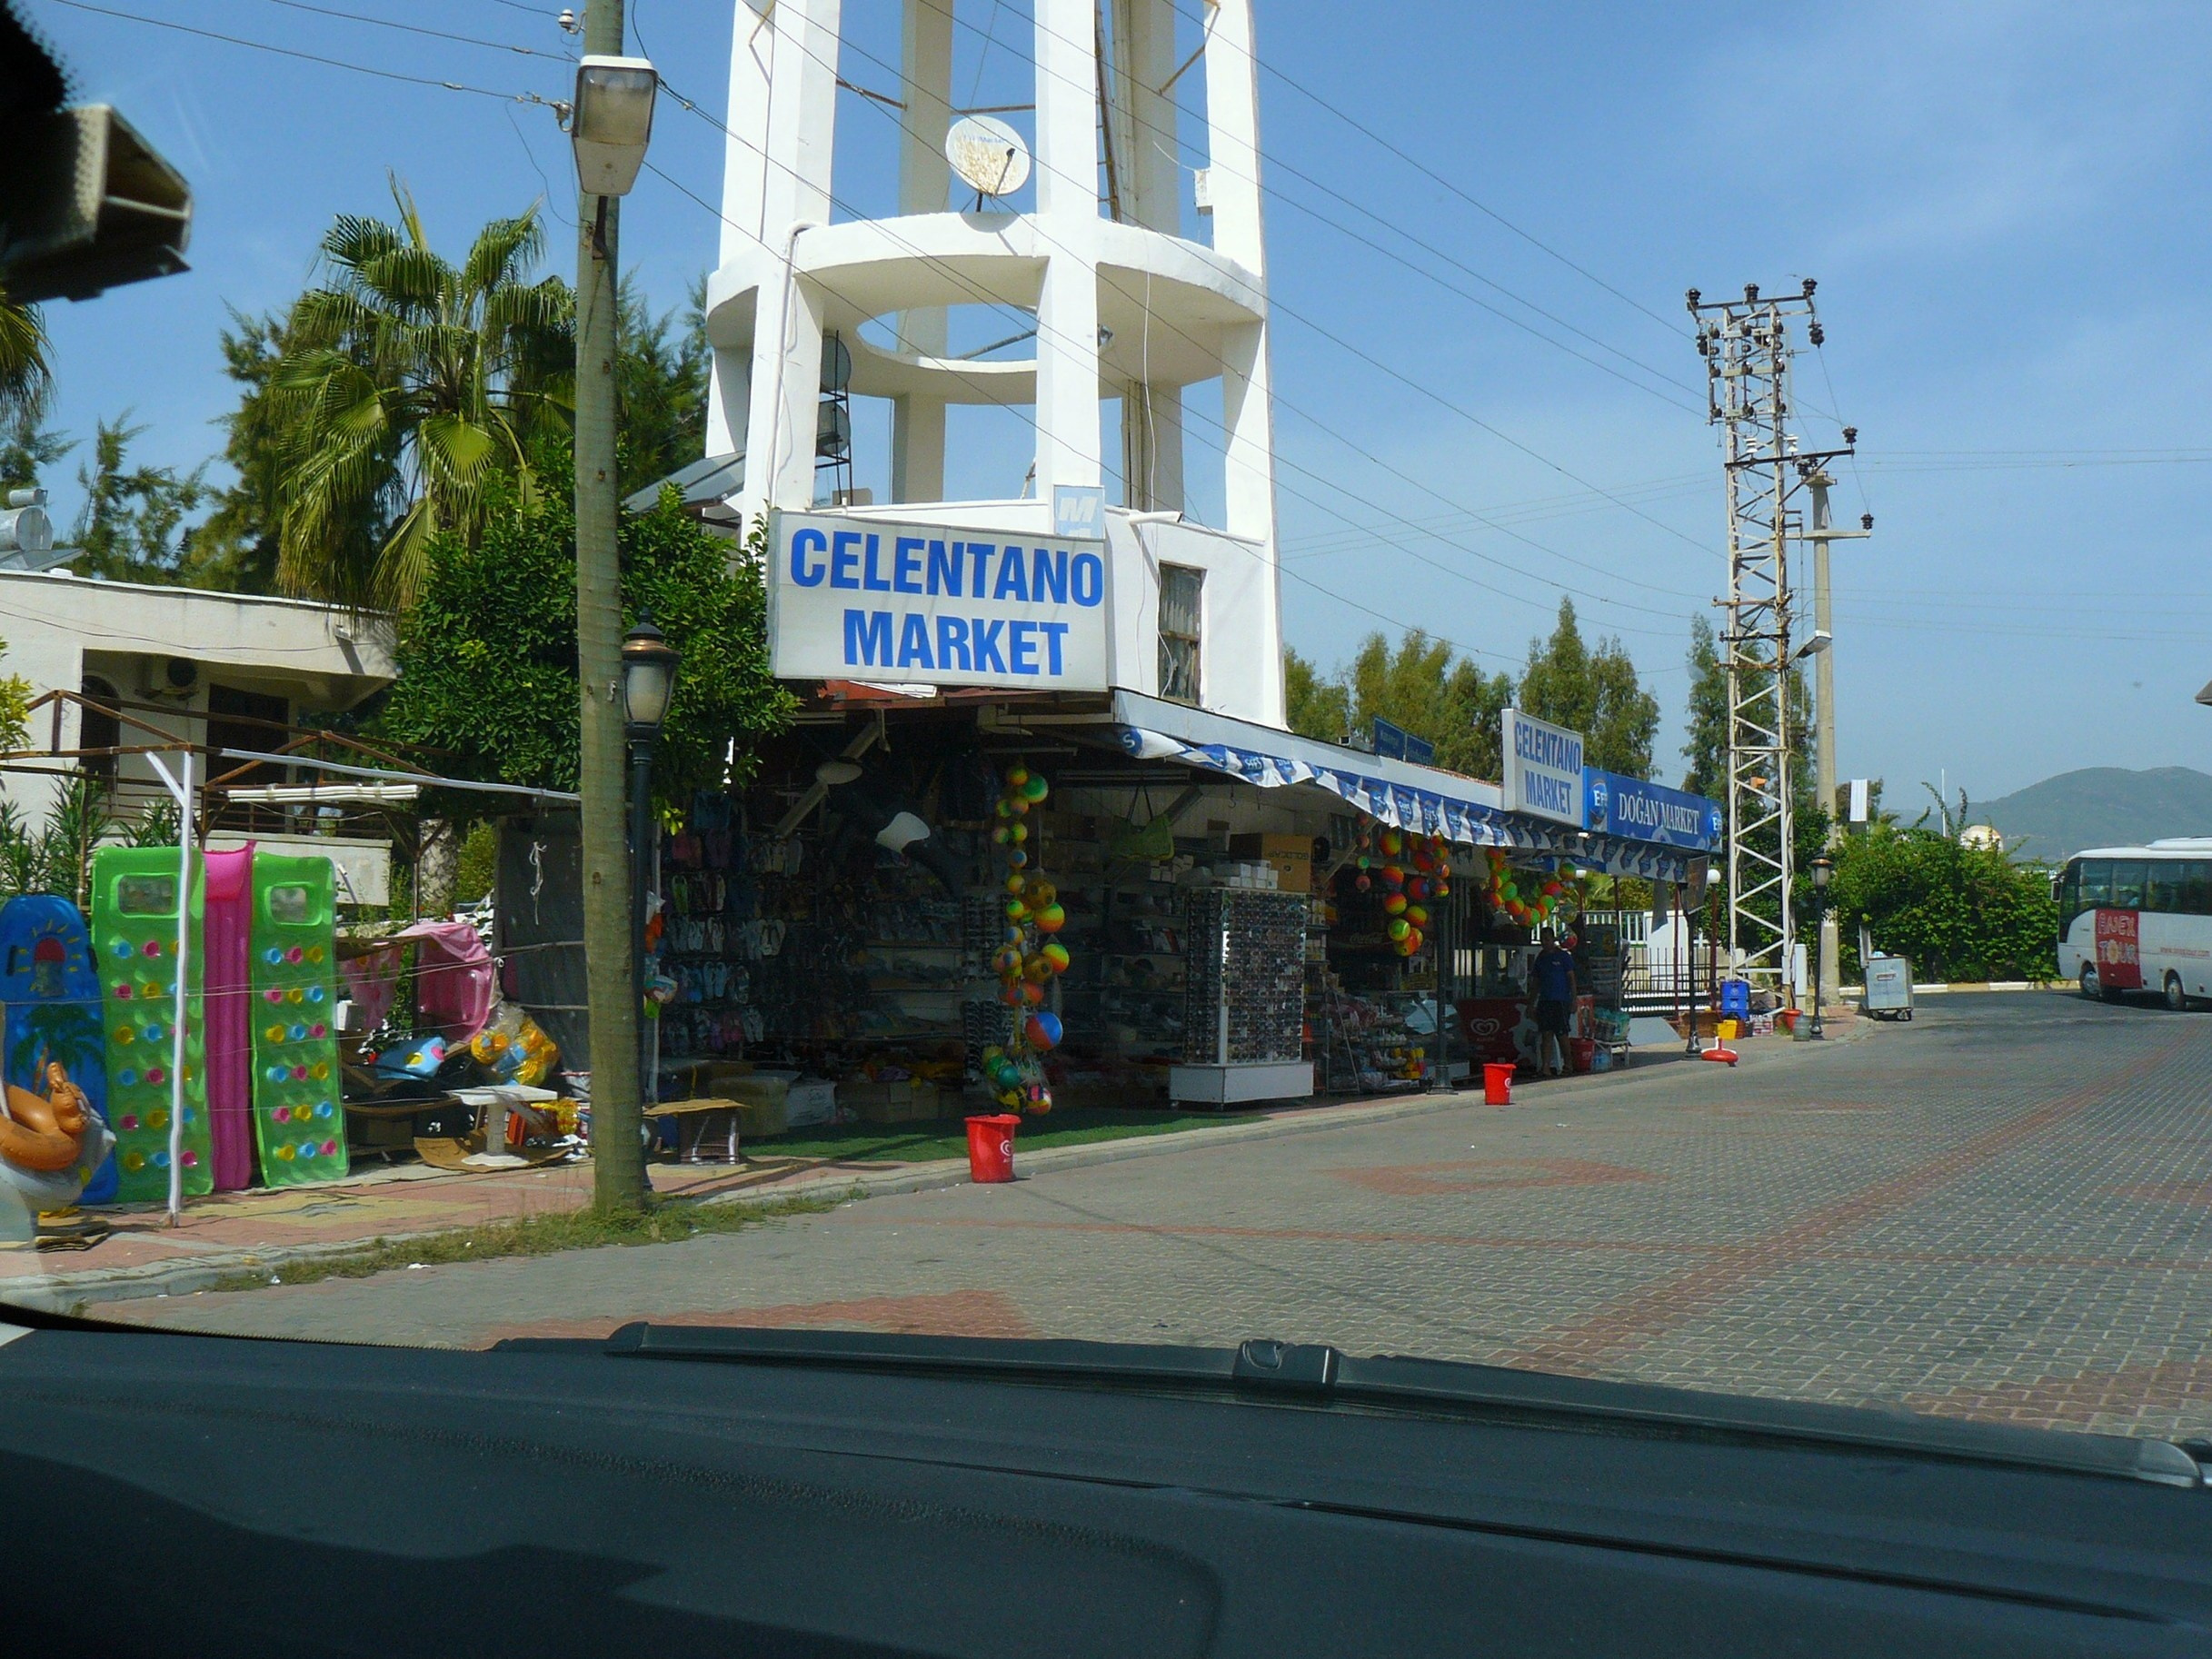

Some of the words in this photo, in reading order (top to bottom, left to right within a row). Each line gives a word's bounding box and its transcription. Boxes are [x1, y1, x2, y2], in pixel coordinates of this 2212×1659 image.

[791, 528, 1103, 607] CELENTANO
[843, 609, 1069, 676] MARKET
[1514, 720, 1581, 776] CELENTANO
[1525, 770, 1572, 815] MARKET
[1618, 789, 1659, 827] DOĞAN
[1660, 802, 1700, 835] MARKET
